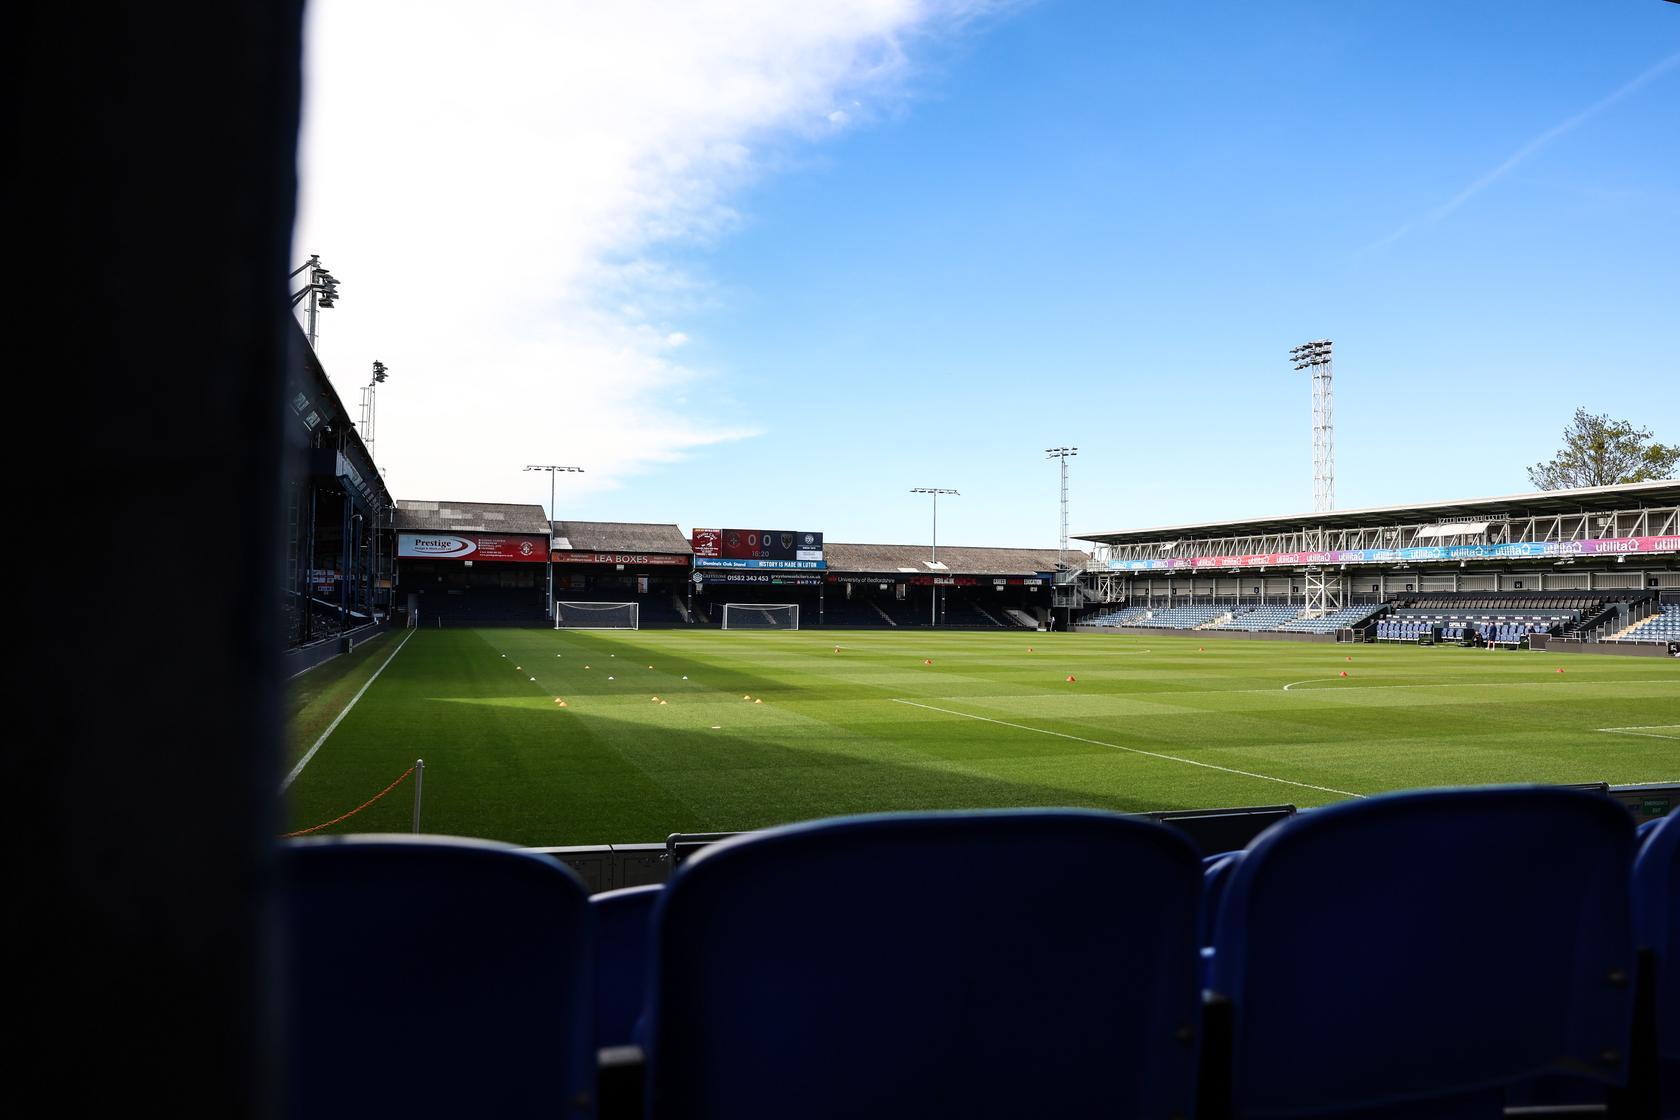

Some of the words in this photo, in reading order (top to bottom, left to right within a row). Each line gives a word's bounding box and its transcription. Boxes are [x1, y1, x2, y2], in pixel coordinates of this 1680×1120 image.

[415, 538, 452, 548] Prestige
[748, 534, 757, 546] 0
[763, 534, 771, 546] 0
[1277, 555, 1293, 564] utilita
[1306, 553, 1325, 562] utilita
[1338, 553, 1358, 561] utilita
[1451, 547, 1476, 558] utilita
[1495, 545, 1521, 556] utilita
[1543, 543, 1572, 554] utilita
[1595, 542, 1628, 552] utilita
[594, 554, 613, 563] LEA
[615, 555, 648, 564] BOXES
[838, 576, 861, 584] University
